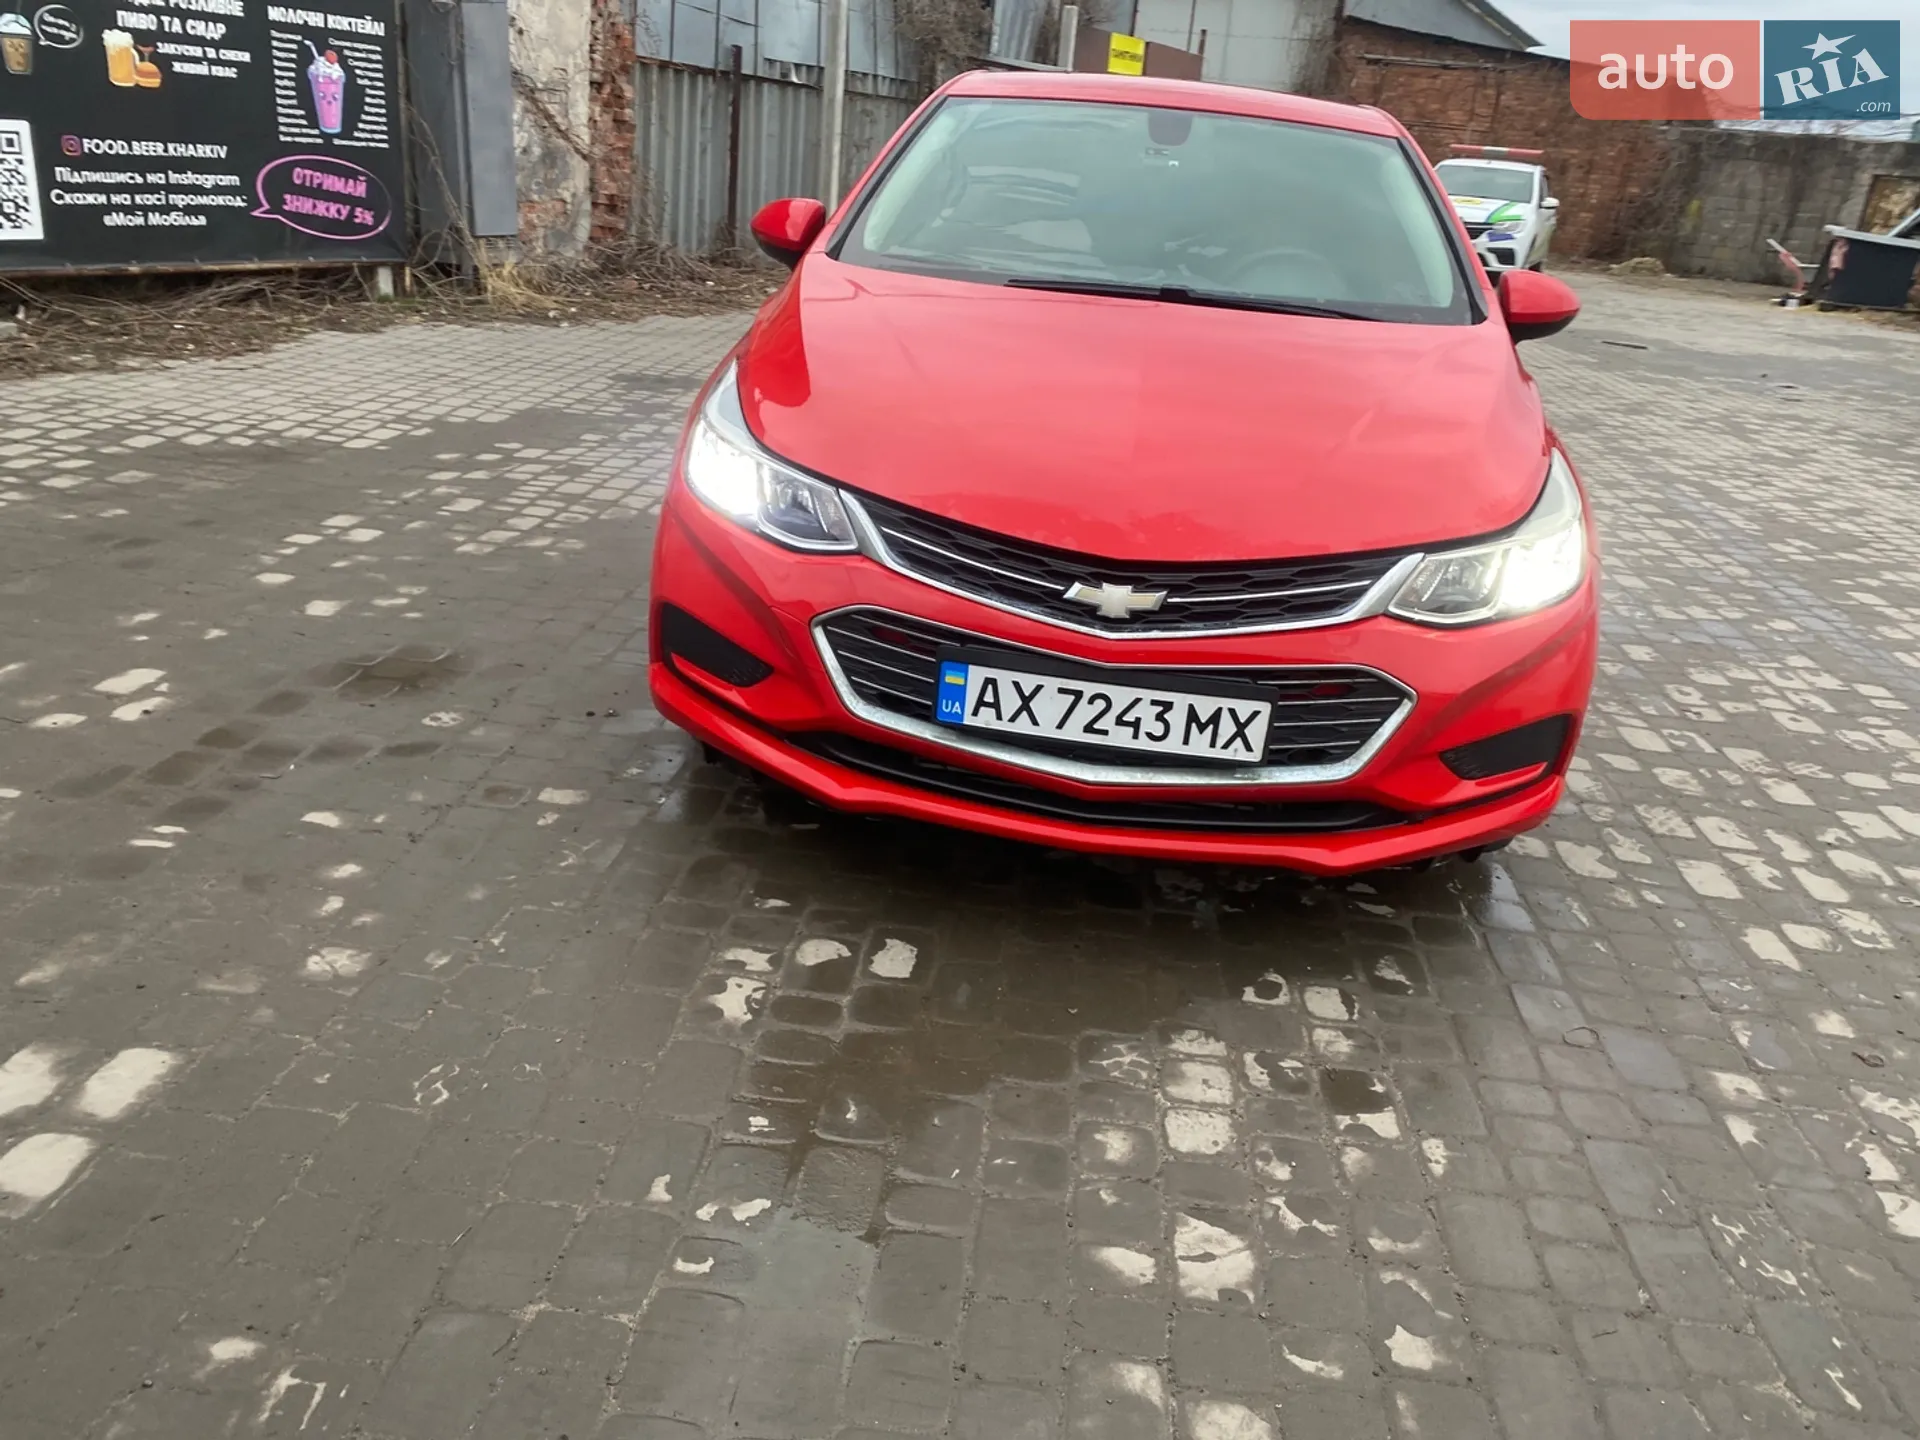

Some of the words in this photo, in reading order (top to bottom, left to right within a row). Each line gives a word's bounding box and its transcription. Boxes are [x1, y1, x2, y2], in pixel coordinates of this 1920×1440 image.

[116, 10, 158, 31] ПИВО
[160, 15, 183, 34] ТА
[186, 19, 227, 40] СИДР
[267, 5, 325, 28] МОЛОЧНІ
[326, 14, 386, 37] КОКТЕЙЛІ
[82, 138, 228, 159] FOOD.BEER.KHARKIV
[54, 166, 144, 184] Підпишись
[146, 172, 166, 184] на
[168, 169, 241, 188] Instagram
[292, 166, 367, 198] ОТРИМАЙ
[50, 189, 107, 205] Скажи
[111, 193, 132, 205] на
[134, 190, 166, 205] касі
[168, 193, 249, 208] промокод:
[282, 193, 351, 221] ЗНИЖКУ
[353, 206, 375, 226] 5%
[942, 700, 963, 716] UA
[971, 676, 1045, 727] AX
[1055, 686, 1175, 743] 7243
[1181, 702, 1262, 753] MX
